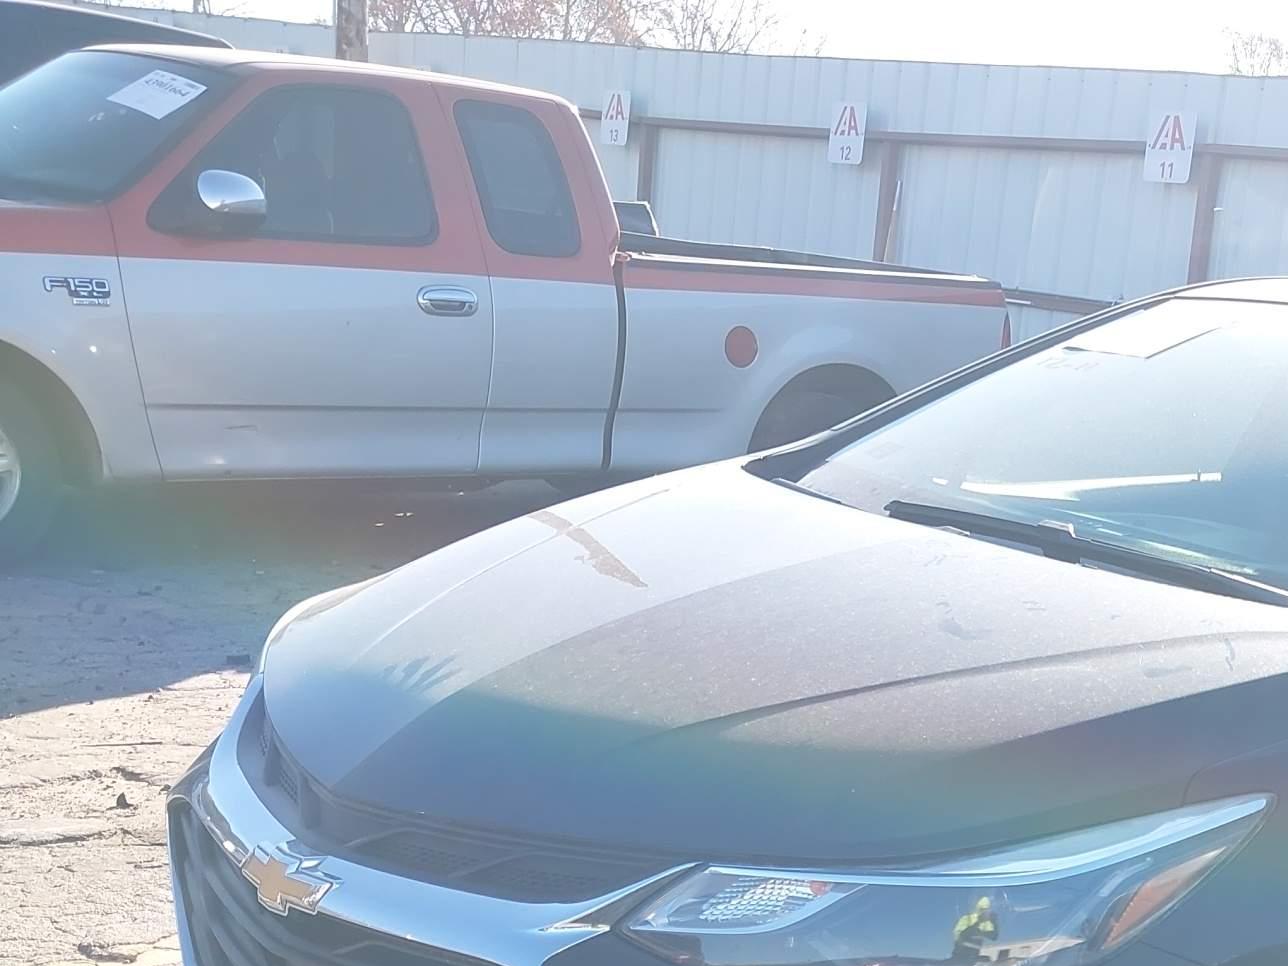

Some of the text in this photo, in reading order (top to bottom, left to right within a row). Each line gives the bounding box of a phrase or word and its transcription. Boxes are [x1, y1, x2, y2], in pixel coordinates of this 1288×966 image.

[610, 129, 619, 142] 13
[840, 145, 852, 161] 12
[1160, 161, 1174, 179] 11
